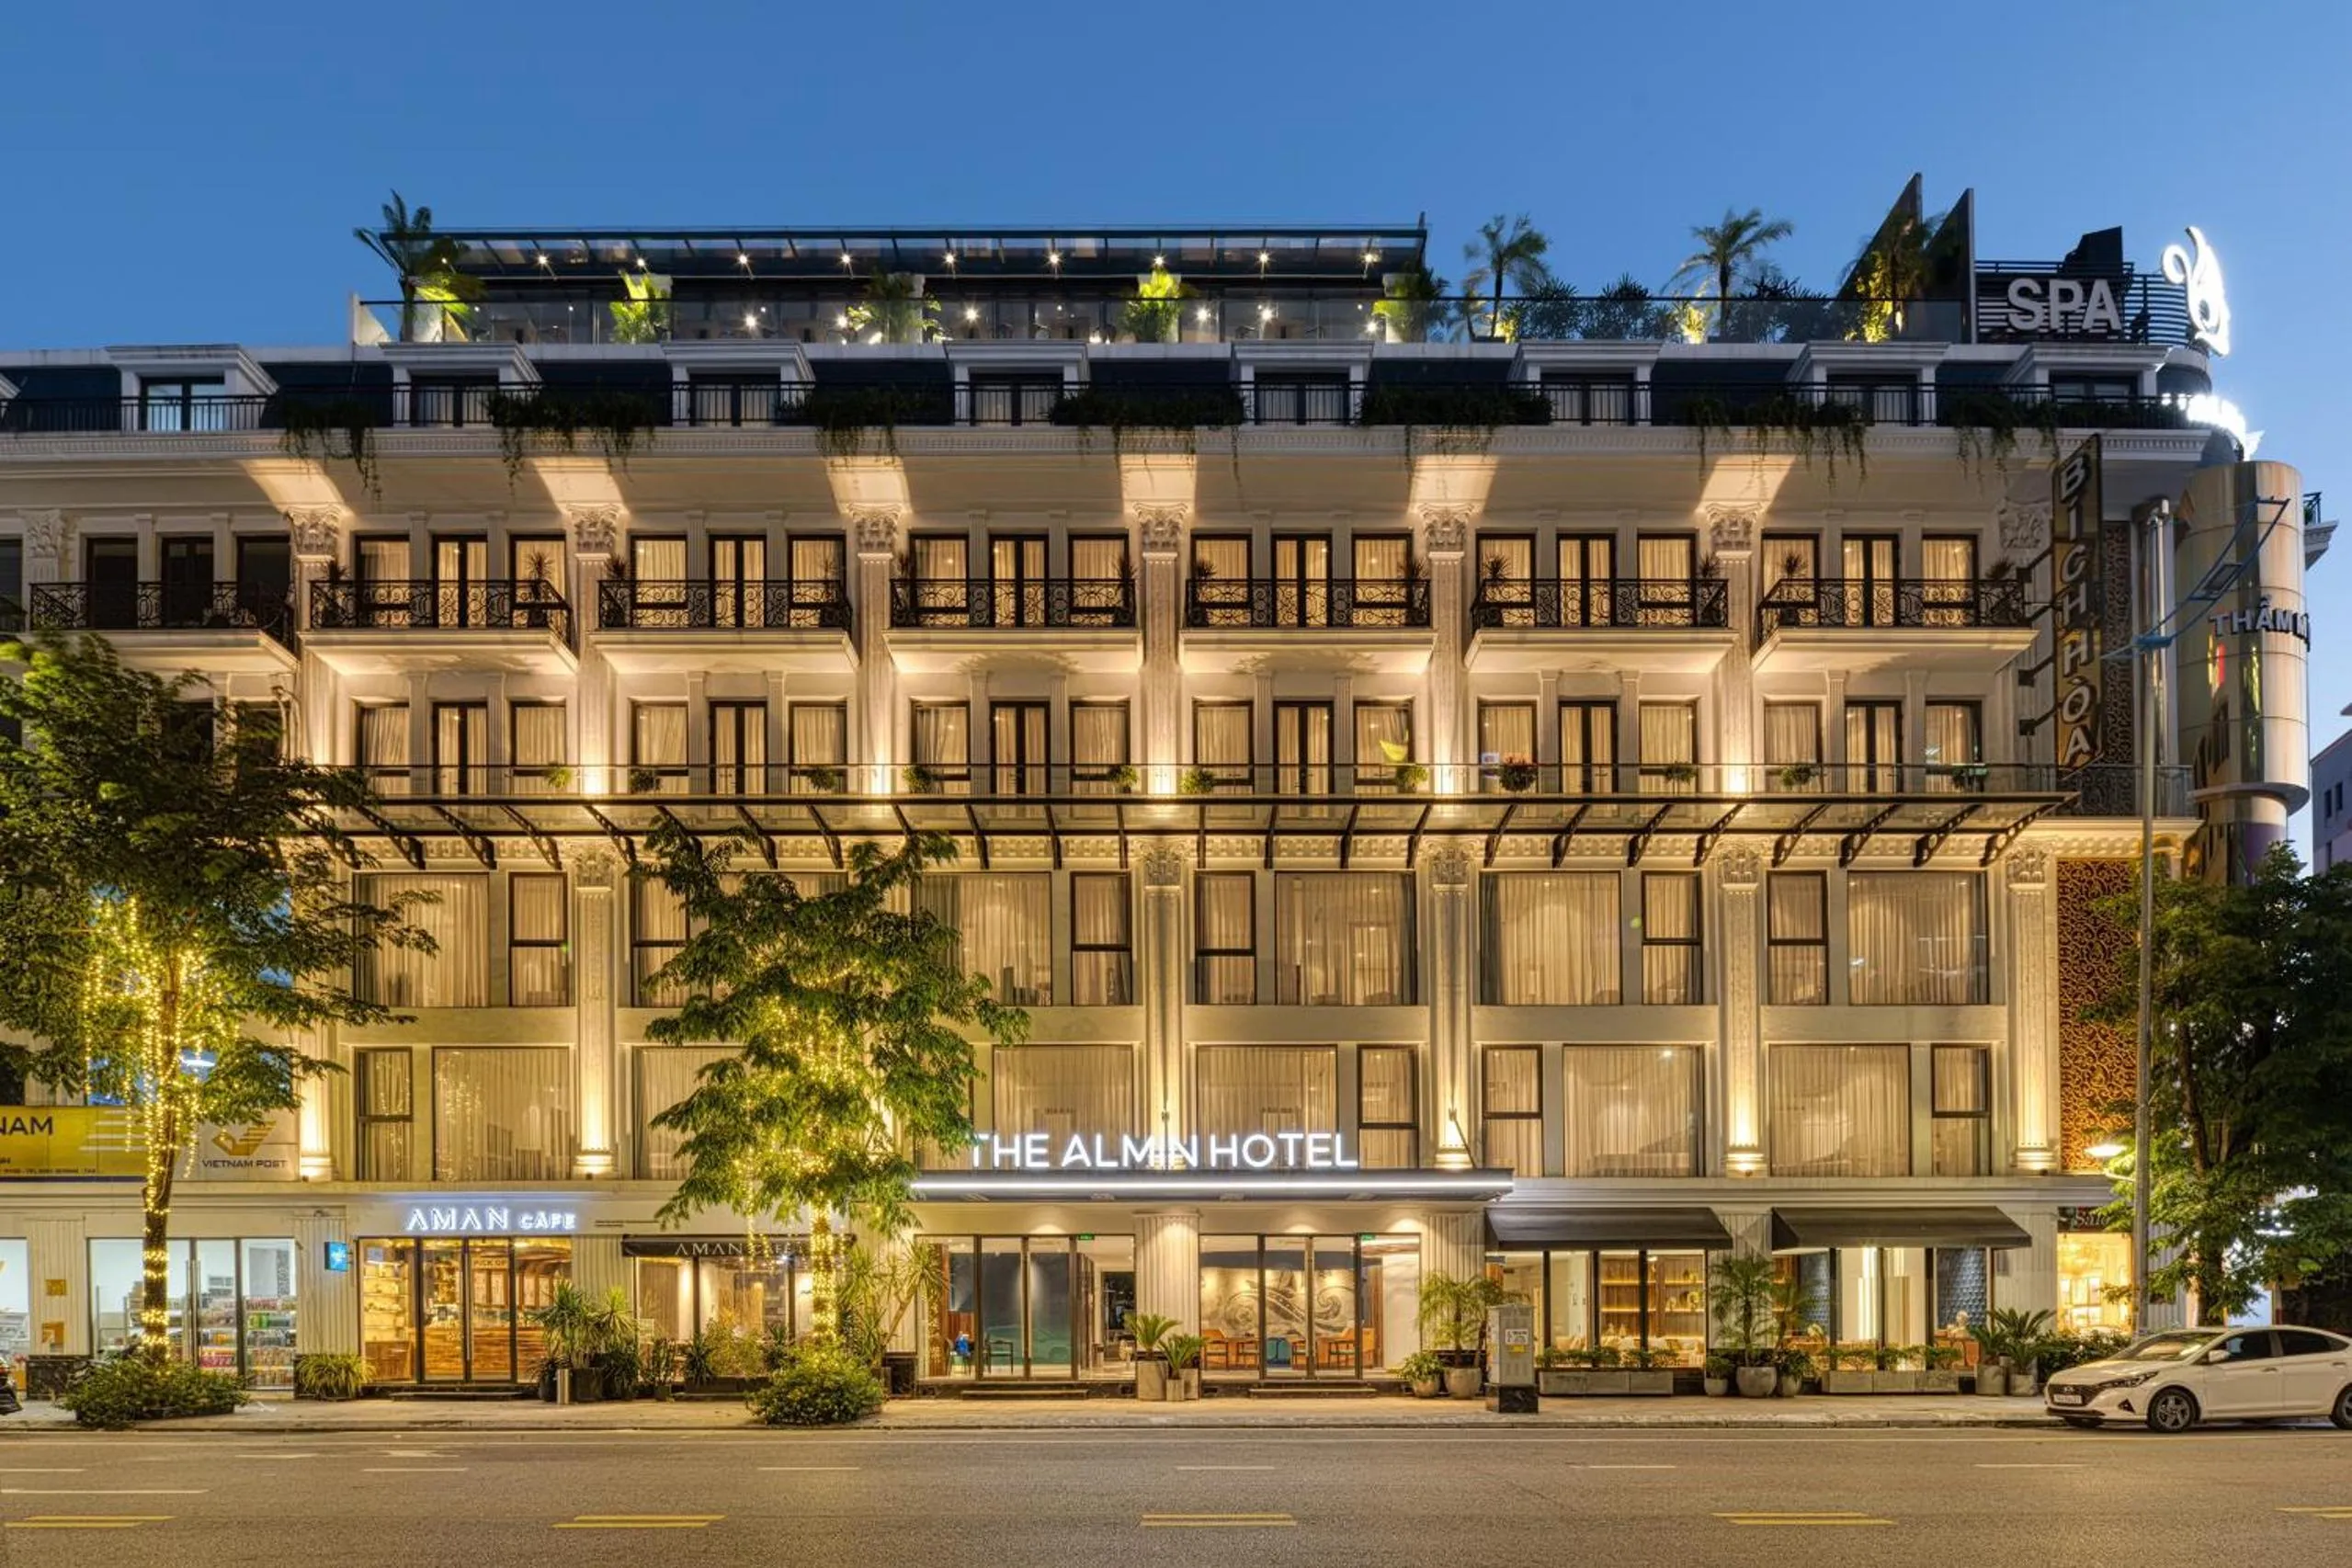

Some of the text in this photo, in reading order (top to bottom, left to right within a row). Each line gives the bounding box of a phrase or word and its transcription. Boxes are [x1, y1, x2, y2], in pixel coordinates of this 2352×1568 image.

[2007, 278, 2122, 330] SPA
[972, 1132, 1358, 1167] THE ALMIN HOTEL
[202, 1160, 288, 1168] VIETNAM POST
[407, 1208, 576, 1231] AMAN CAFE
[675, 1243, 743, 1256] AMAN
